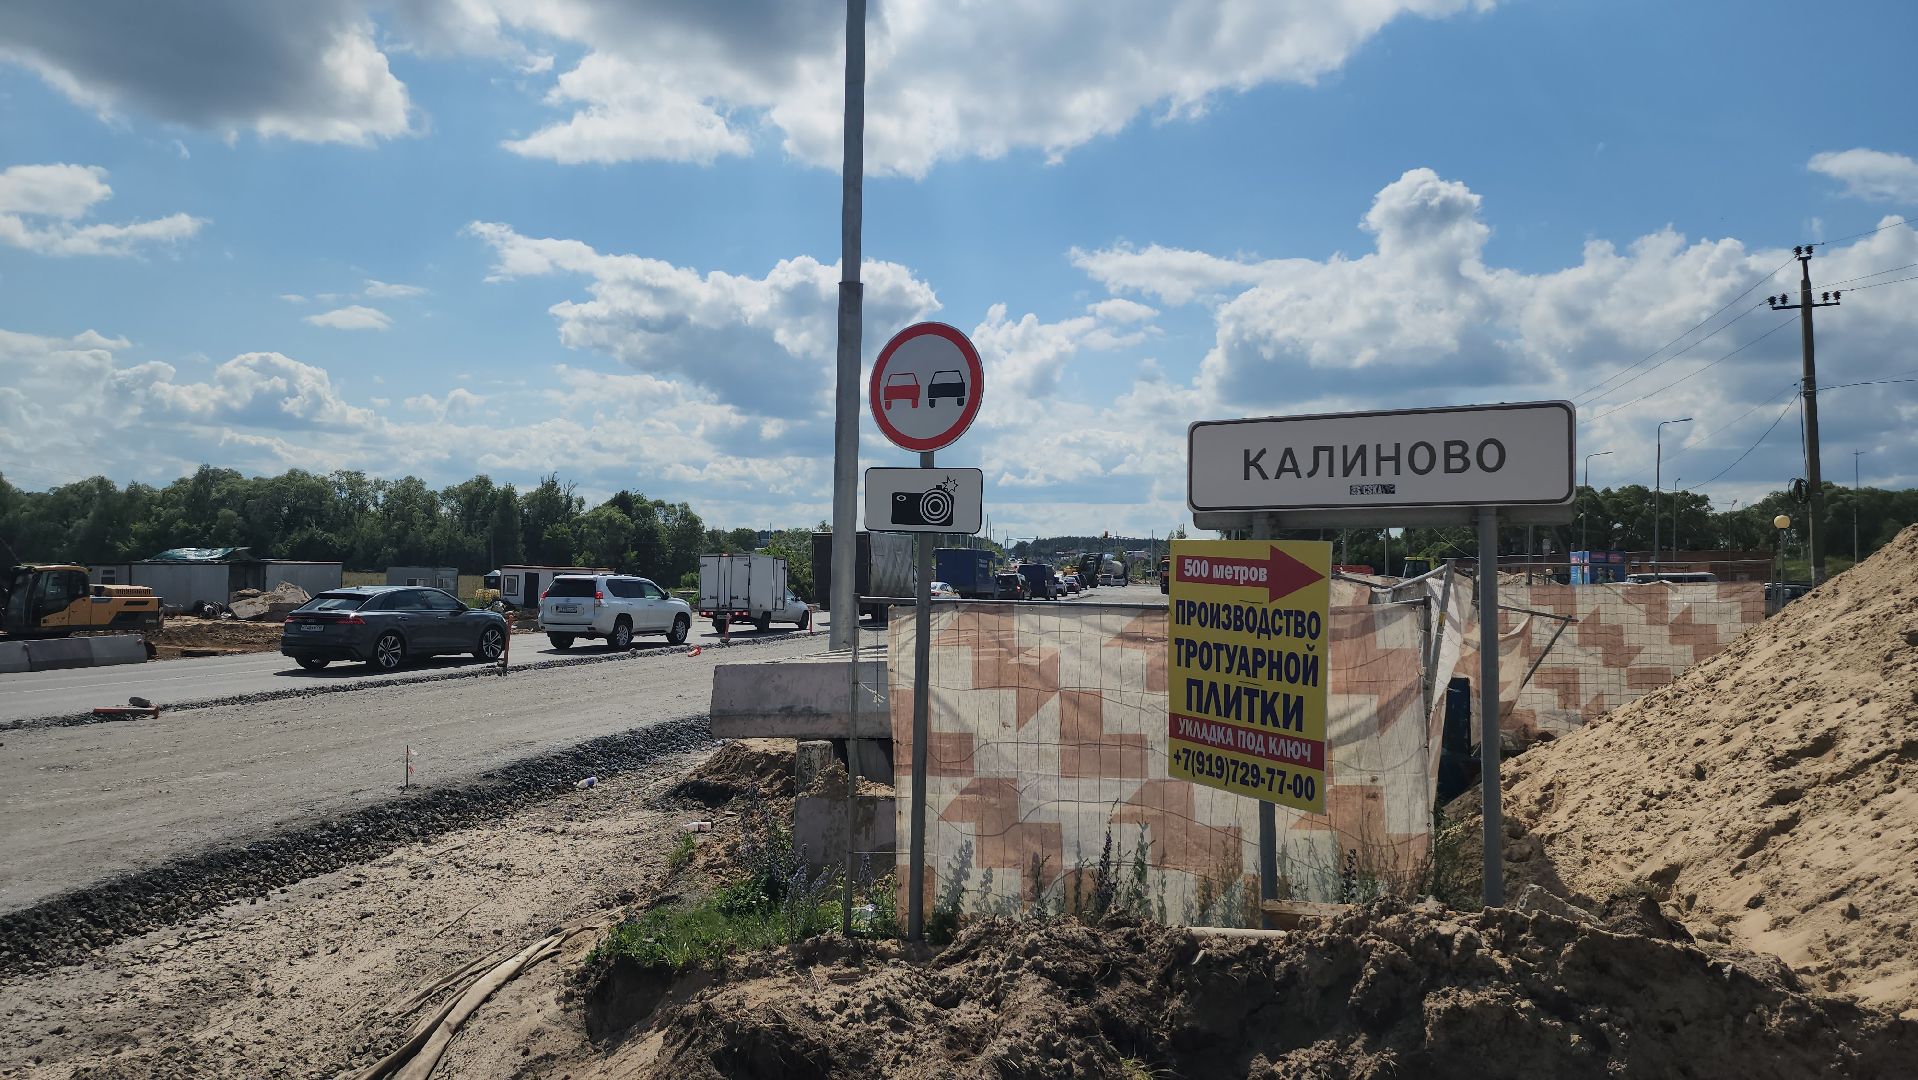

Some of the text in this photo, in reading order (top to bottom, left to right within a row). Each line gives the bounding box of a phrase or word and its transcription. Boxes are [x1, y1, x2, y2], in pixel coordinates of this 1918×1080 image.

[1243, 437, 1507, 481] КАЛИНОВО
[1184, 558, 1268, 584] 500 метров
[1175, 599, 1321, 641] ПРОИЗВОДСТВО
[1174, 637, 1319, 687] ТРОТУАРНОЙ
[1186, 678, 1304, 732] ПЛИТКИ
[1178, 718, 1312, 762] УКЛАДКА ПОД КЛЮЧ
[1173, 747, 1316, 801] +7(919)729-77-00
